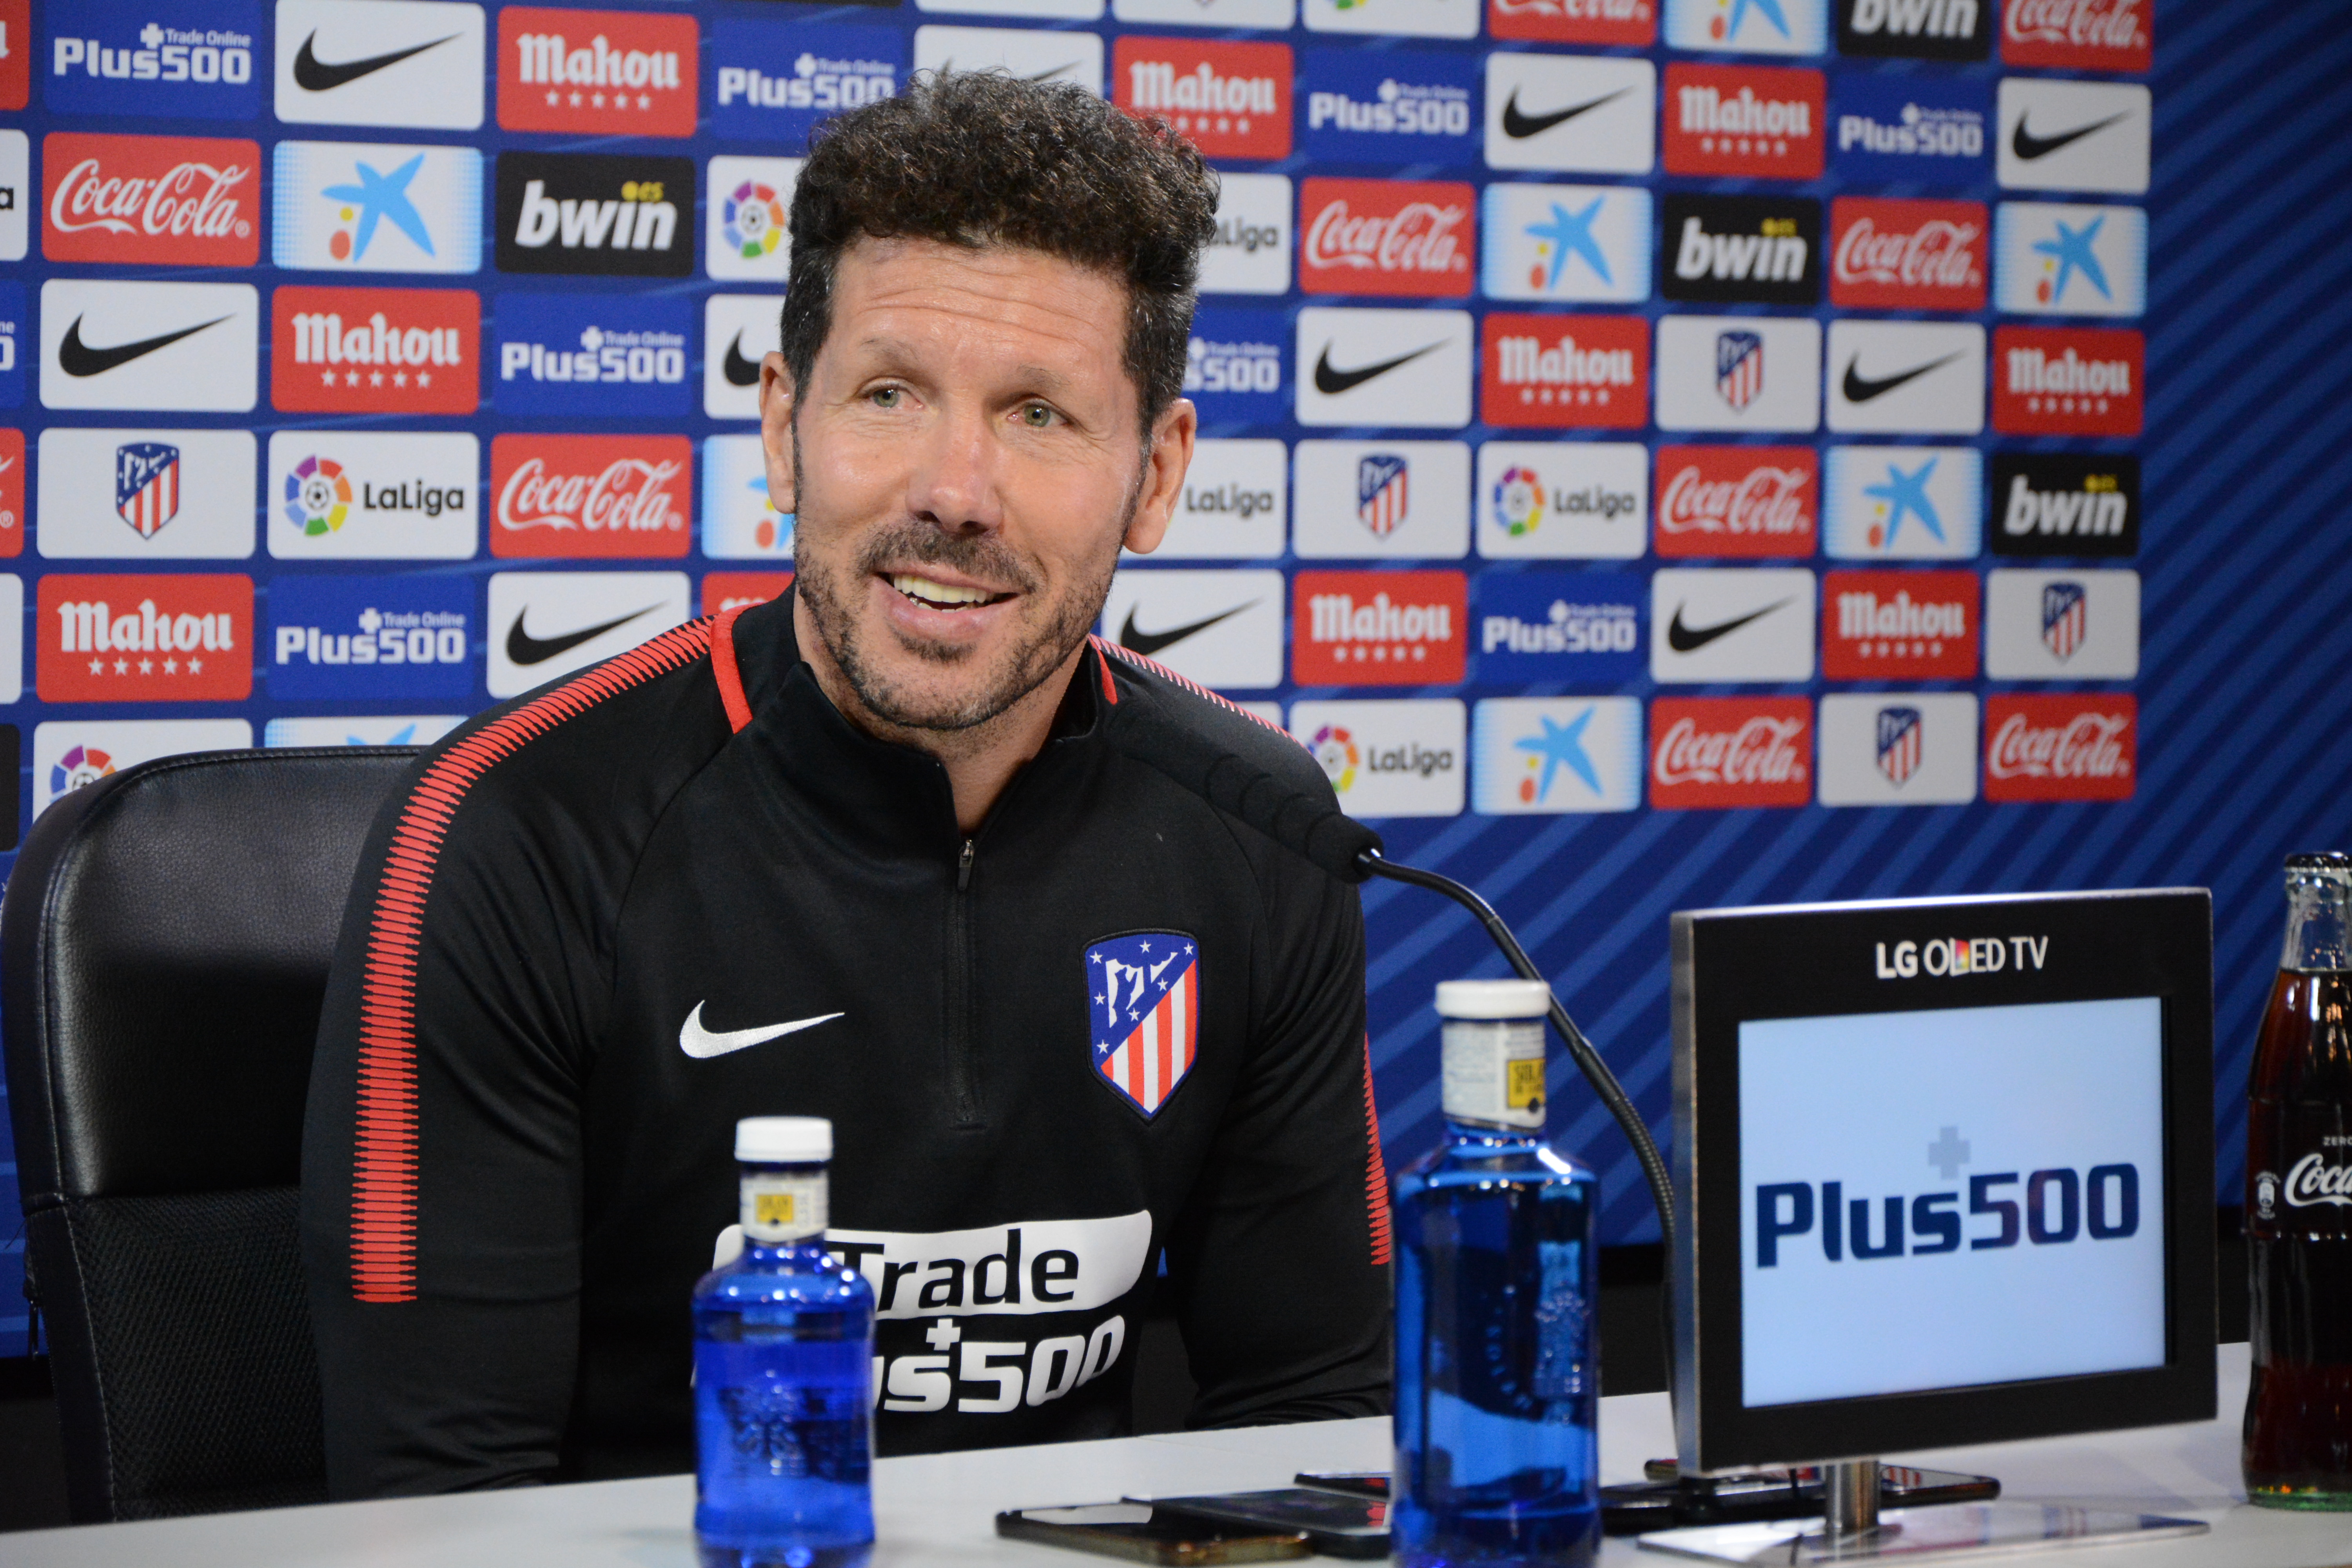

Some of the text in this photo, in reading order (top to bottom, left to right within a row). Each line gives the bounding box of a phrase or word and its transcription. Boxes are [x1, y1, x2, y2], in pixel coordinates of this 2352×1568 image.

[165, 28, 251, 47] Trade Online
[54, 38, 252, 84] Plus500
[517, 33, 680, 89] Mahou
[718, 66, 896, 109] Plus500
[1129, 61, 1276, 114] Mahou
[1679, 85, 1810, 136] Mahou
[1308, 92, 1469, 135] Plus500
[1838, 116, 1984, 156] Plus500
[515, 180, 677, 250] bwin
[1676, 217, 1807, 281] bwin
[291, 312, 461, 366] Mahou
[1497, 336, 1634, 386] Mahou
[501, 343, 684, 383] Plus500
[1182, 357, 1280, 392] s500
[2007, 347, 2130, 396] Mahou
[364, 479, 464, 518] LaLiga
[1185, 483, 1274, 520] LaLiga
[1554, 486, 1636, 521] LaLiga
[2005, 475, 2127, 535] bwin
[57, 599, 234, 652] Mahou
[1310, 592, 1451, 642] Mahou
[1483, 616, 1637, 653] Plus500
[1837, 591, 1965, 639] Mahou
[276, 626, 466, 664] Plus500
[1368, 744, 1453, 779] LaLiga
[1876, 936, 2048, 979] LG OLED TV
[1756, 1163, 2140, 1269] Plus500
